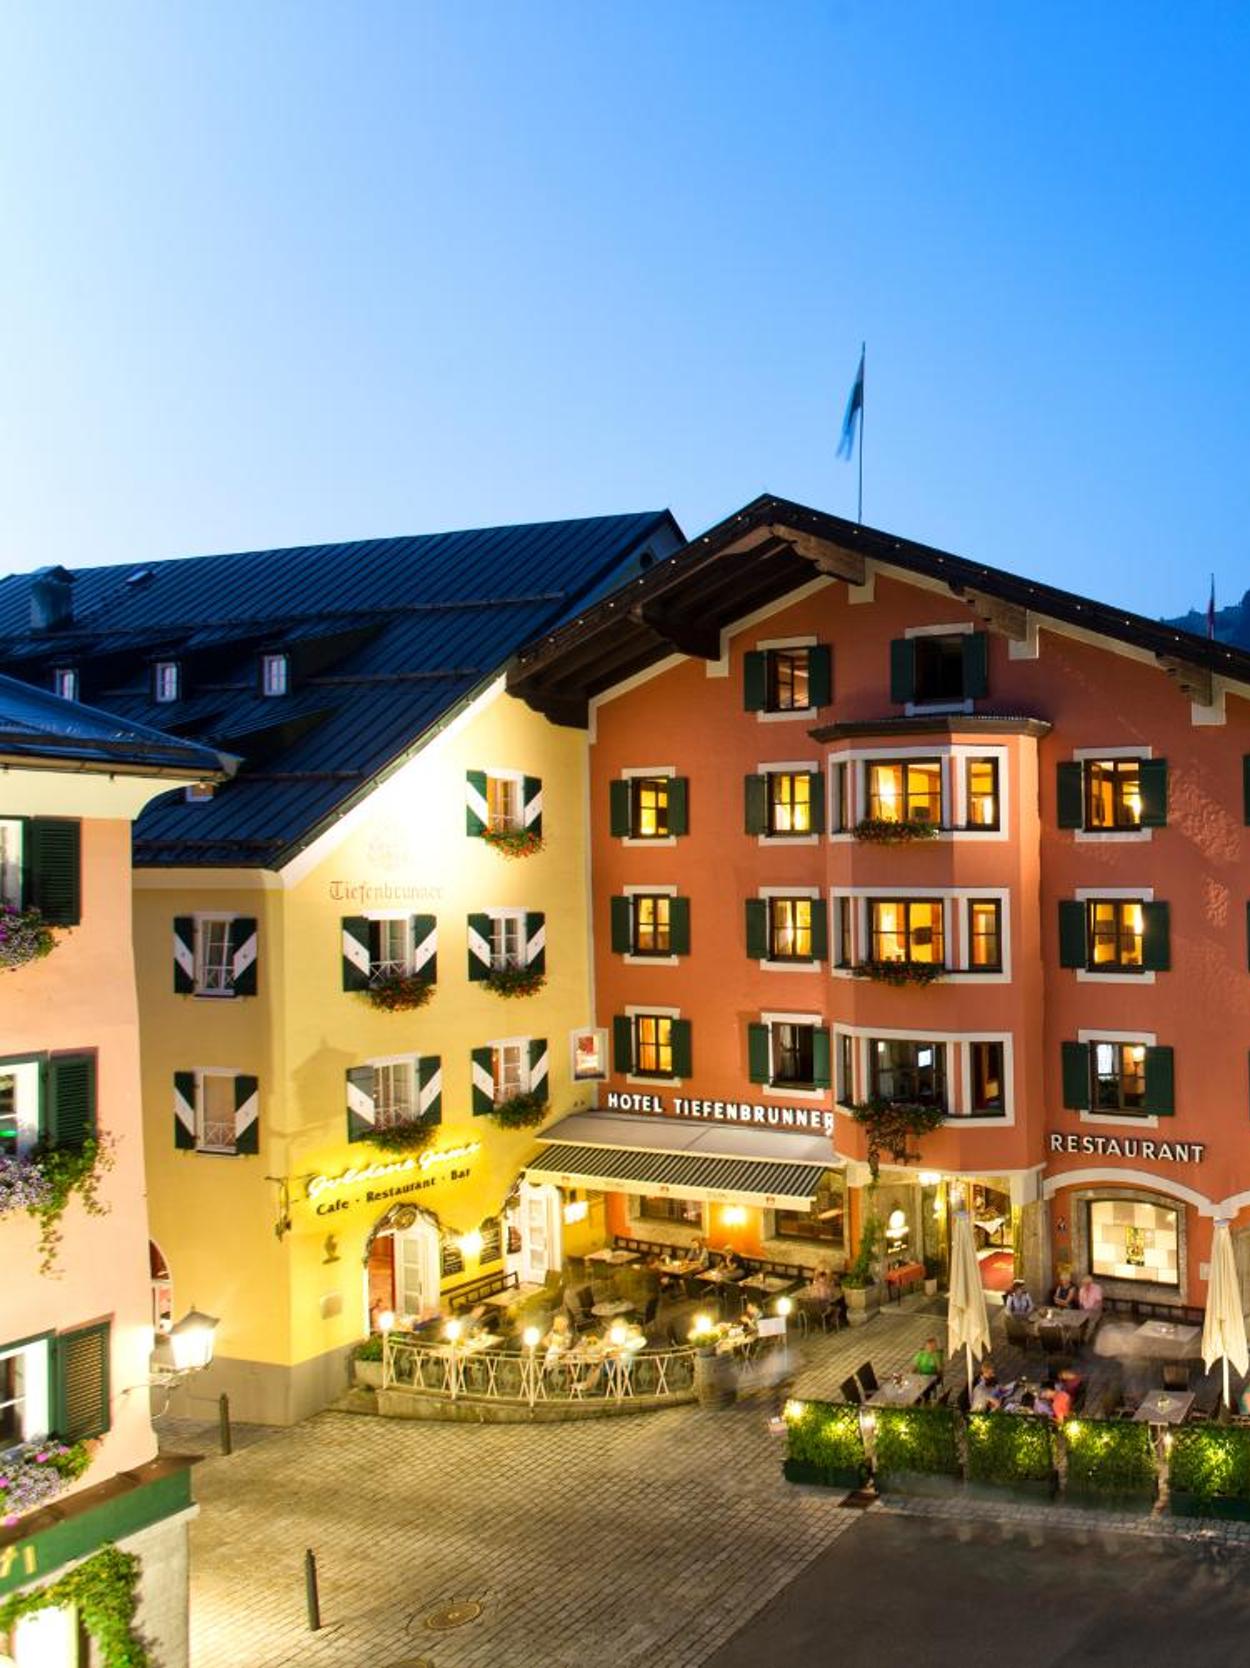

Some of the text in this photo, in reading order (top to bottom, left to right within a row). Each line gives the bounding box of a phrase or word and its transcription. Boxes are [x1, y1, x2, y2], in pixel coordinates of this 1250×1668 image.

[608, 1092, 834, 1128] HOTEL TIEFENBRUNNER
[1050, 1134, 1203, 1163] RESTAURANT
[366, 1176, 435, 1202] Restaurant
[451, 1168, 470, 1181] Bar
